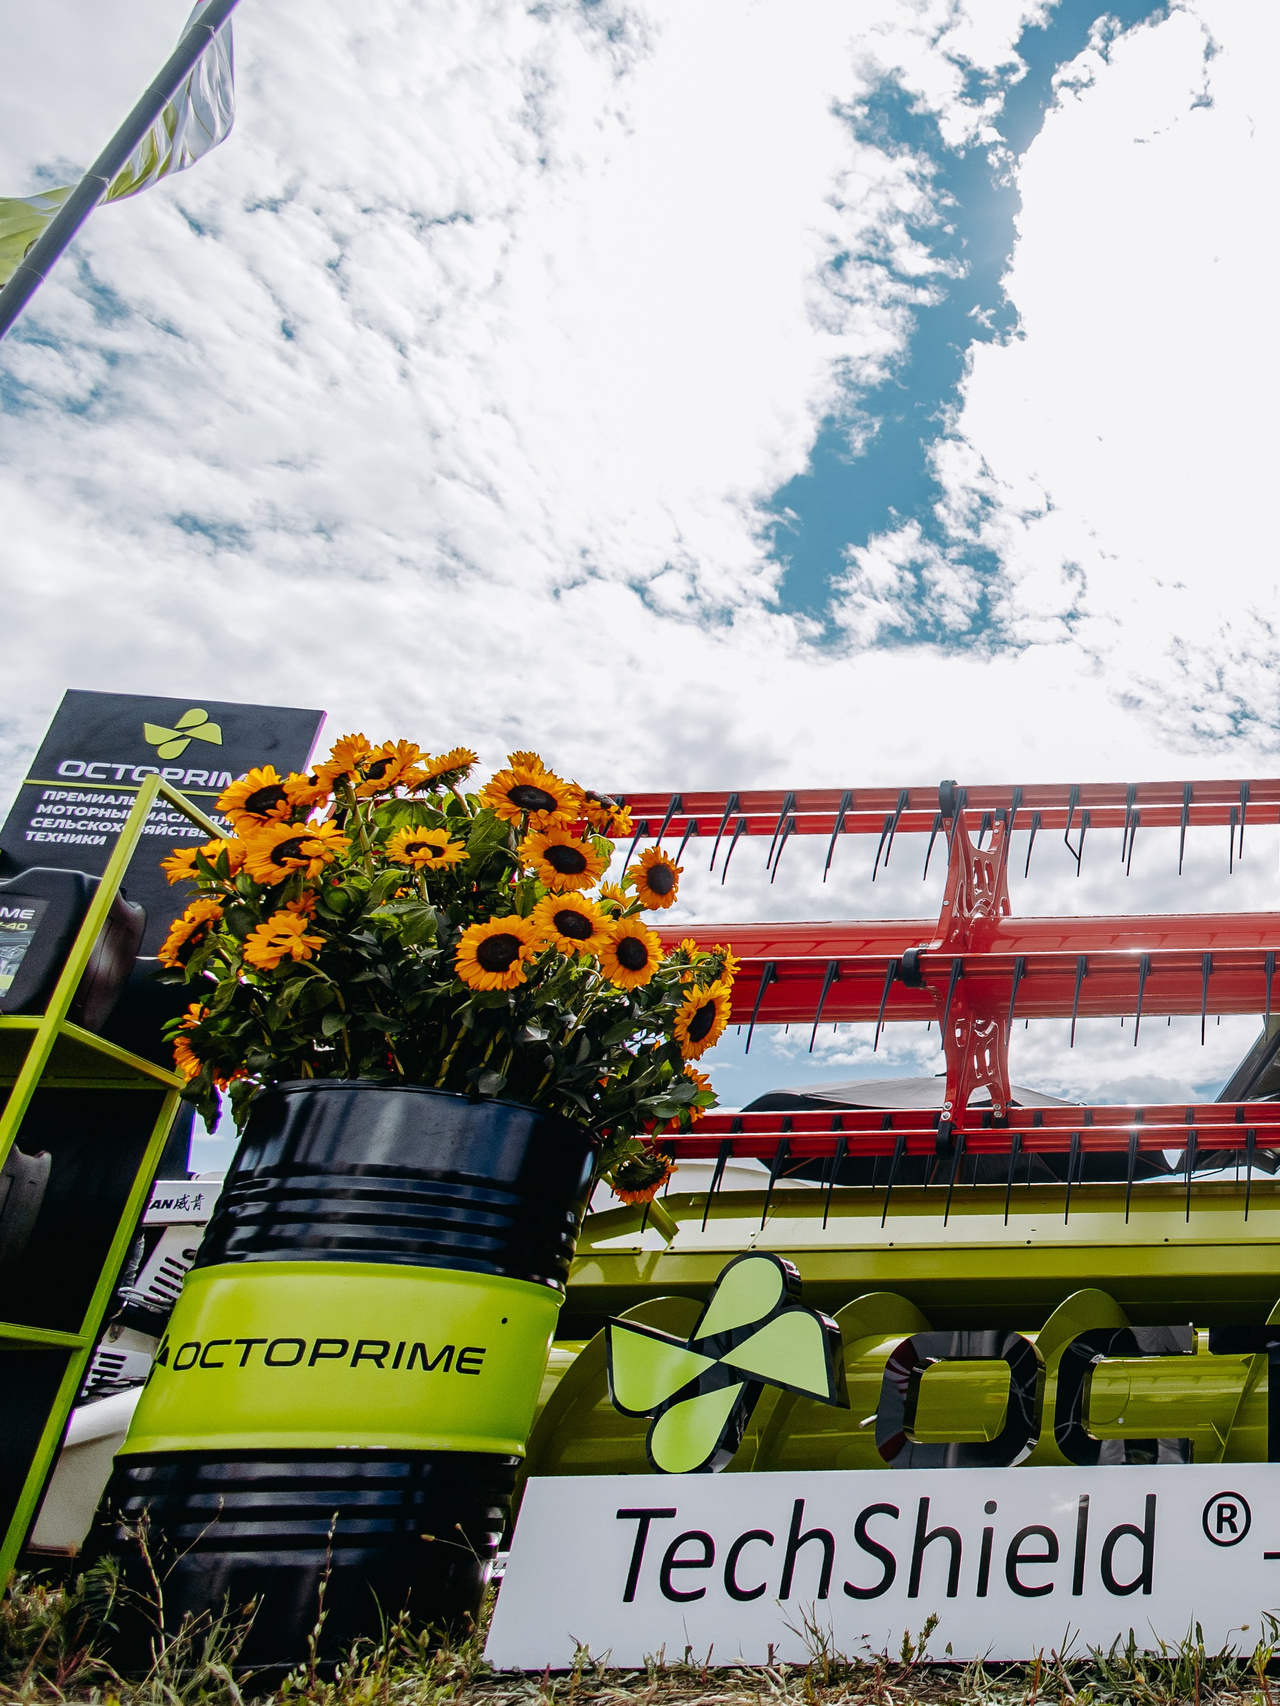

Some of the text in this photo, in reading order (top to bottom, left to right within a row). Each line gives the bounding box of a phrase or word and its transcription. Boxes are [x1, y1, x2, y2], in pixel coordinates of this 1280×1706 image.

[57, 760, 247, 788] OCTOPRIM
[42, 790, 175, 809] ПРЕМИАЛЬЫ
[36, 804, 133, 819] МОТОРНЫ
[24, 831, 107, 845] ТЕХНИКИ
[173, 1338, 486, 1375] OCTOPRIME
[614, 1492, 1157, 1602] TechShield
